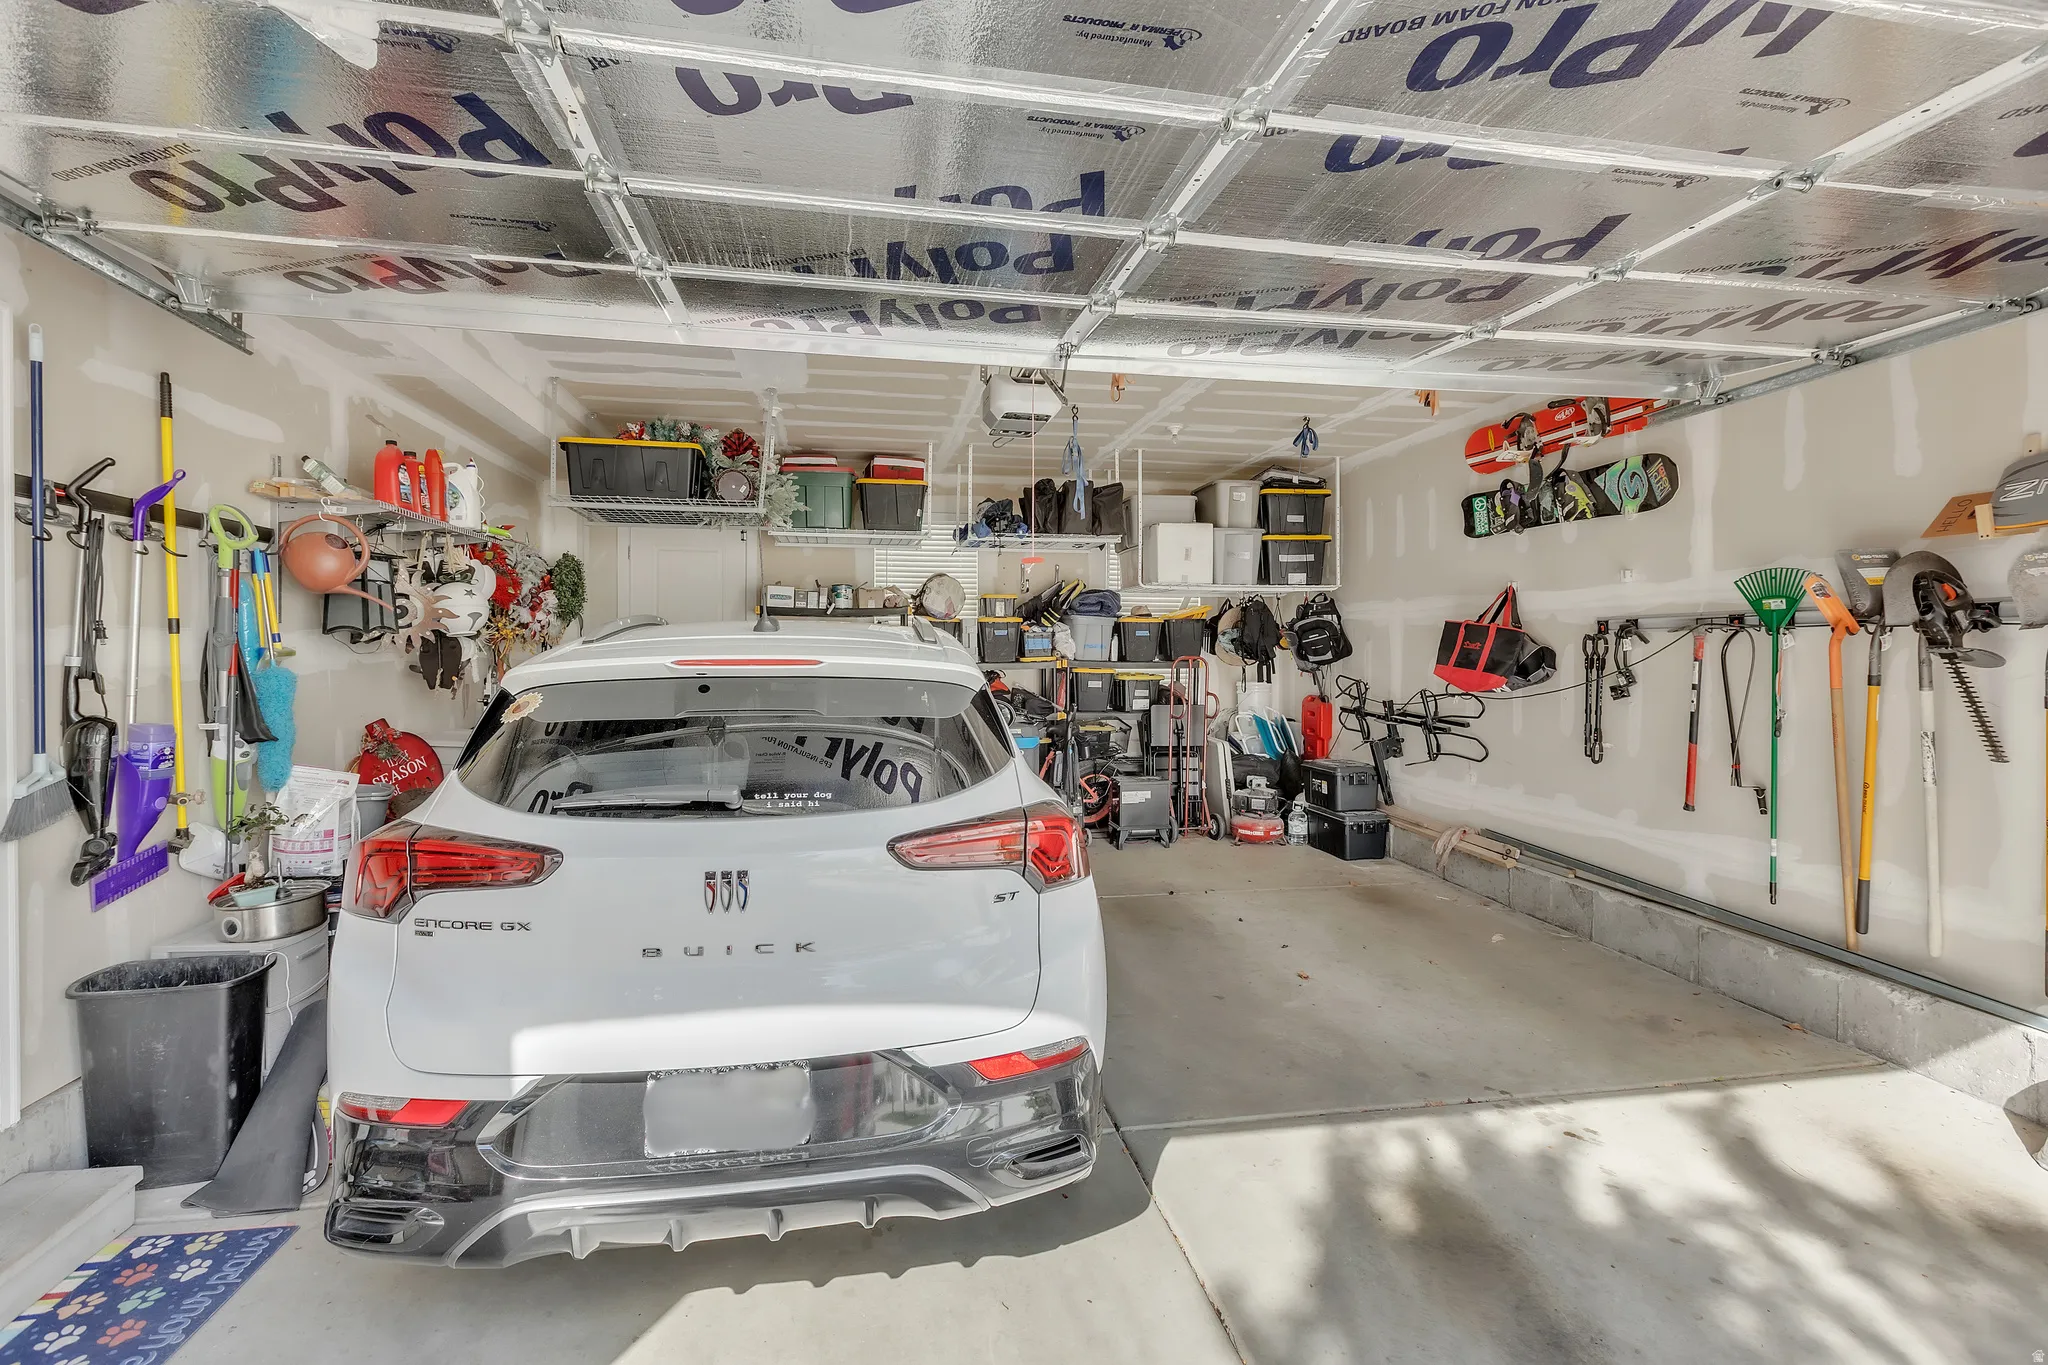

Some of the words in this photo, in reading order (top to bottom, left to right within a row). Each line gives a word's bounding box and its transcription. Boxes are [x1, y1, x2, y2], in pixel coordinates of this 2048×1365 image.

[1432, 0, 1511, 26] FOAM
[1063, 14, 1126, 30] PRODUCTS
[1075, 30, 1090, 40] by:
[1339, 16, 1426, 44] BOARD
[1091, 32, 1153, 48] Manufactured
[1027, 115, 1080, 127] PRODUCTS
[1051, 128, 1105, 140] Manufactured
[99, 155, 136, 174] FOAM
[51, 164, 100, 182] BOARD
[450, 214, 497, 222] PRODUCTS
[760, 251, 839, 268] INSULATION
[1795, 244, 1908, 261] INSULATION
[1741, 257, 1793, 268] FOAM
[1211, 286, 1295, 299] INSULATION
[771, 305, 838, 318] INSULATION
[1206, 329, 1278, 339] INSULATION
[1936, 498, 1973, 533] HELLO
[372, 756, 428, 785] SEASON
[784, 792, 809, 801] your
[814, 792, 832, 801] dog
[992, 891, 1020, 904] ST
[414, 917, 493, 931] ENCORE
[500, 921, 531, 931] GX
[642, 941, 816, 958] BUICK
